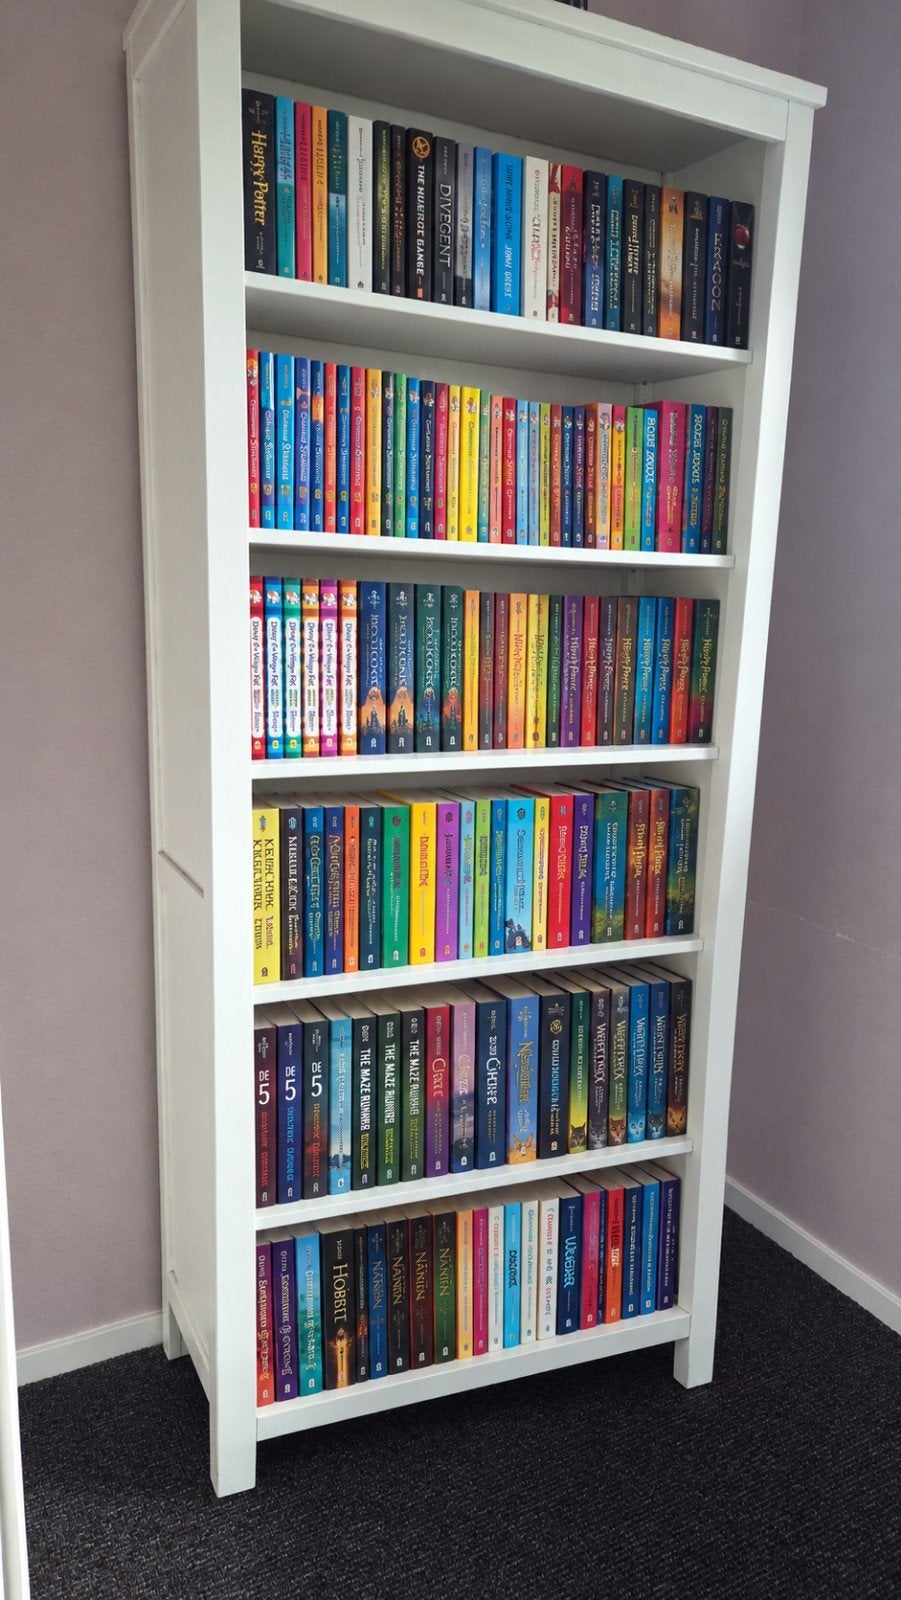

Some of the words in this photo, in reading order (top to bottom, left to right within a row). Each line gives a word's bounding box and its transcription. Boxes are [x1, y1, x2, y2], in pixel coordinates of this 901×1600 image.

[417, 165, 425, 184] THE
[360, 1048, 370, 1067] THE
[385, 1043, 395, 1061] THE
[410, 1039, 419, 1057] THE
[360, 1068, 370, 1094] MAZE
[385, 1063, 395, 1088] MAZE
